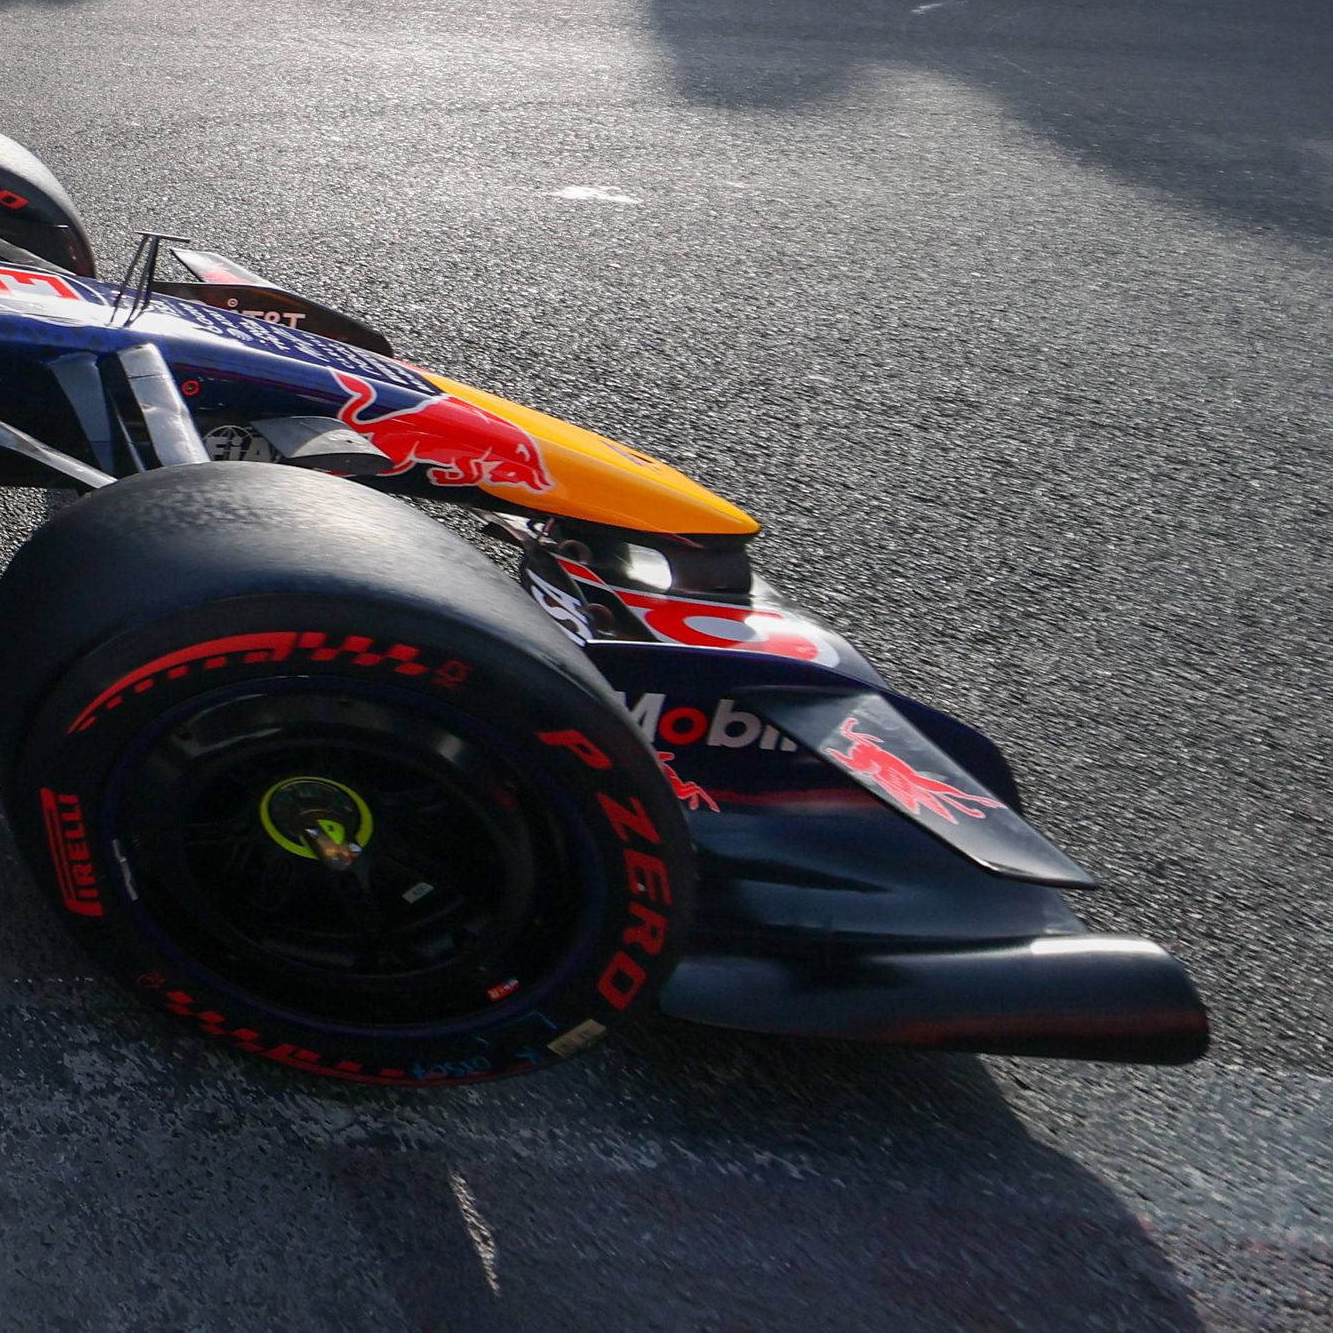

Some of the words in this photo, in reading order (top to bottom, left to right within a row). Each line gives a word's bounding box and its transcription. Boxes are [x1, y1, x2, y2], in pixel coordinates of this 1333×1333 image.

[236, 311, 306, 330] T&T
[614, 690, 799, 753] Mob
[40, 787, 103, 917] PIRELLI
[538, 730, 612, 770] P
[597, 796, 673, 1011] ZERO
